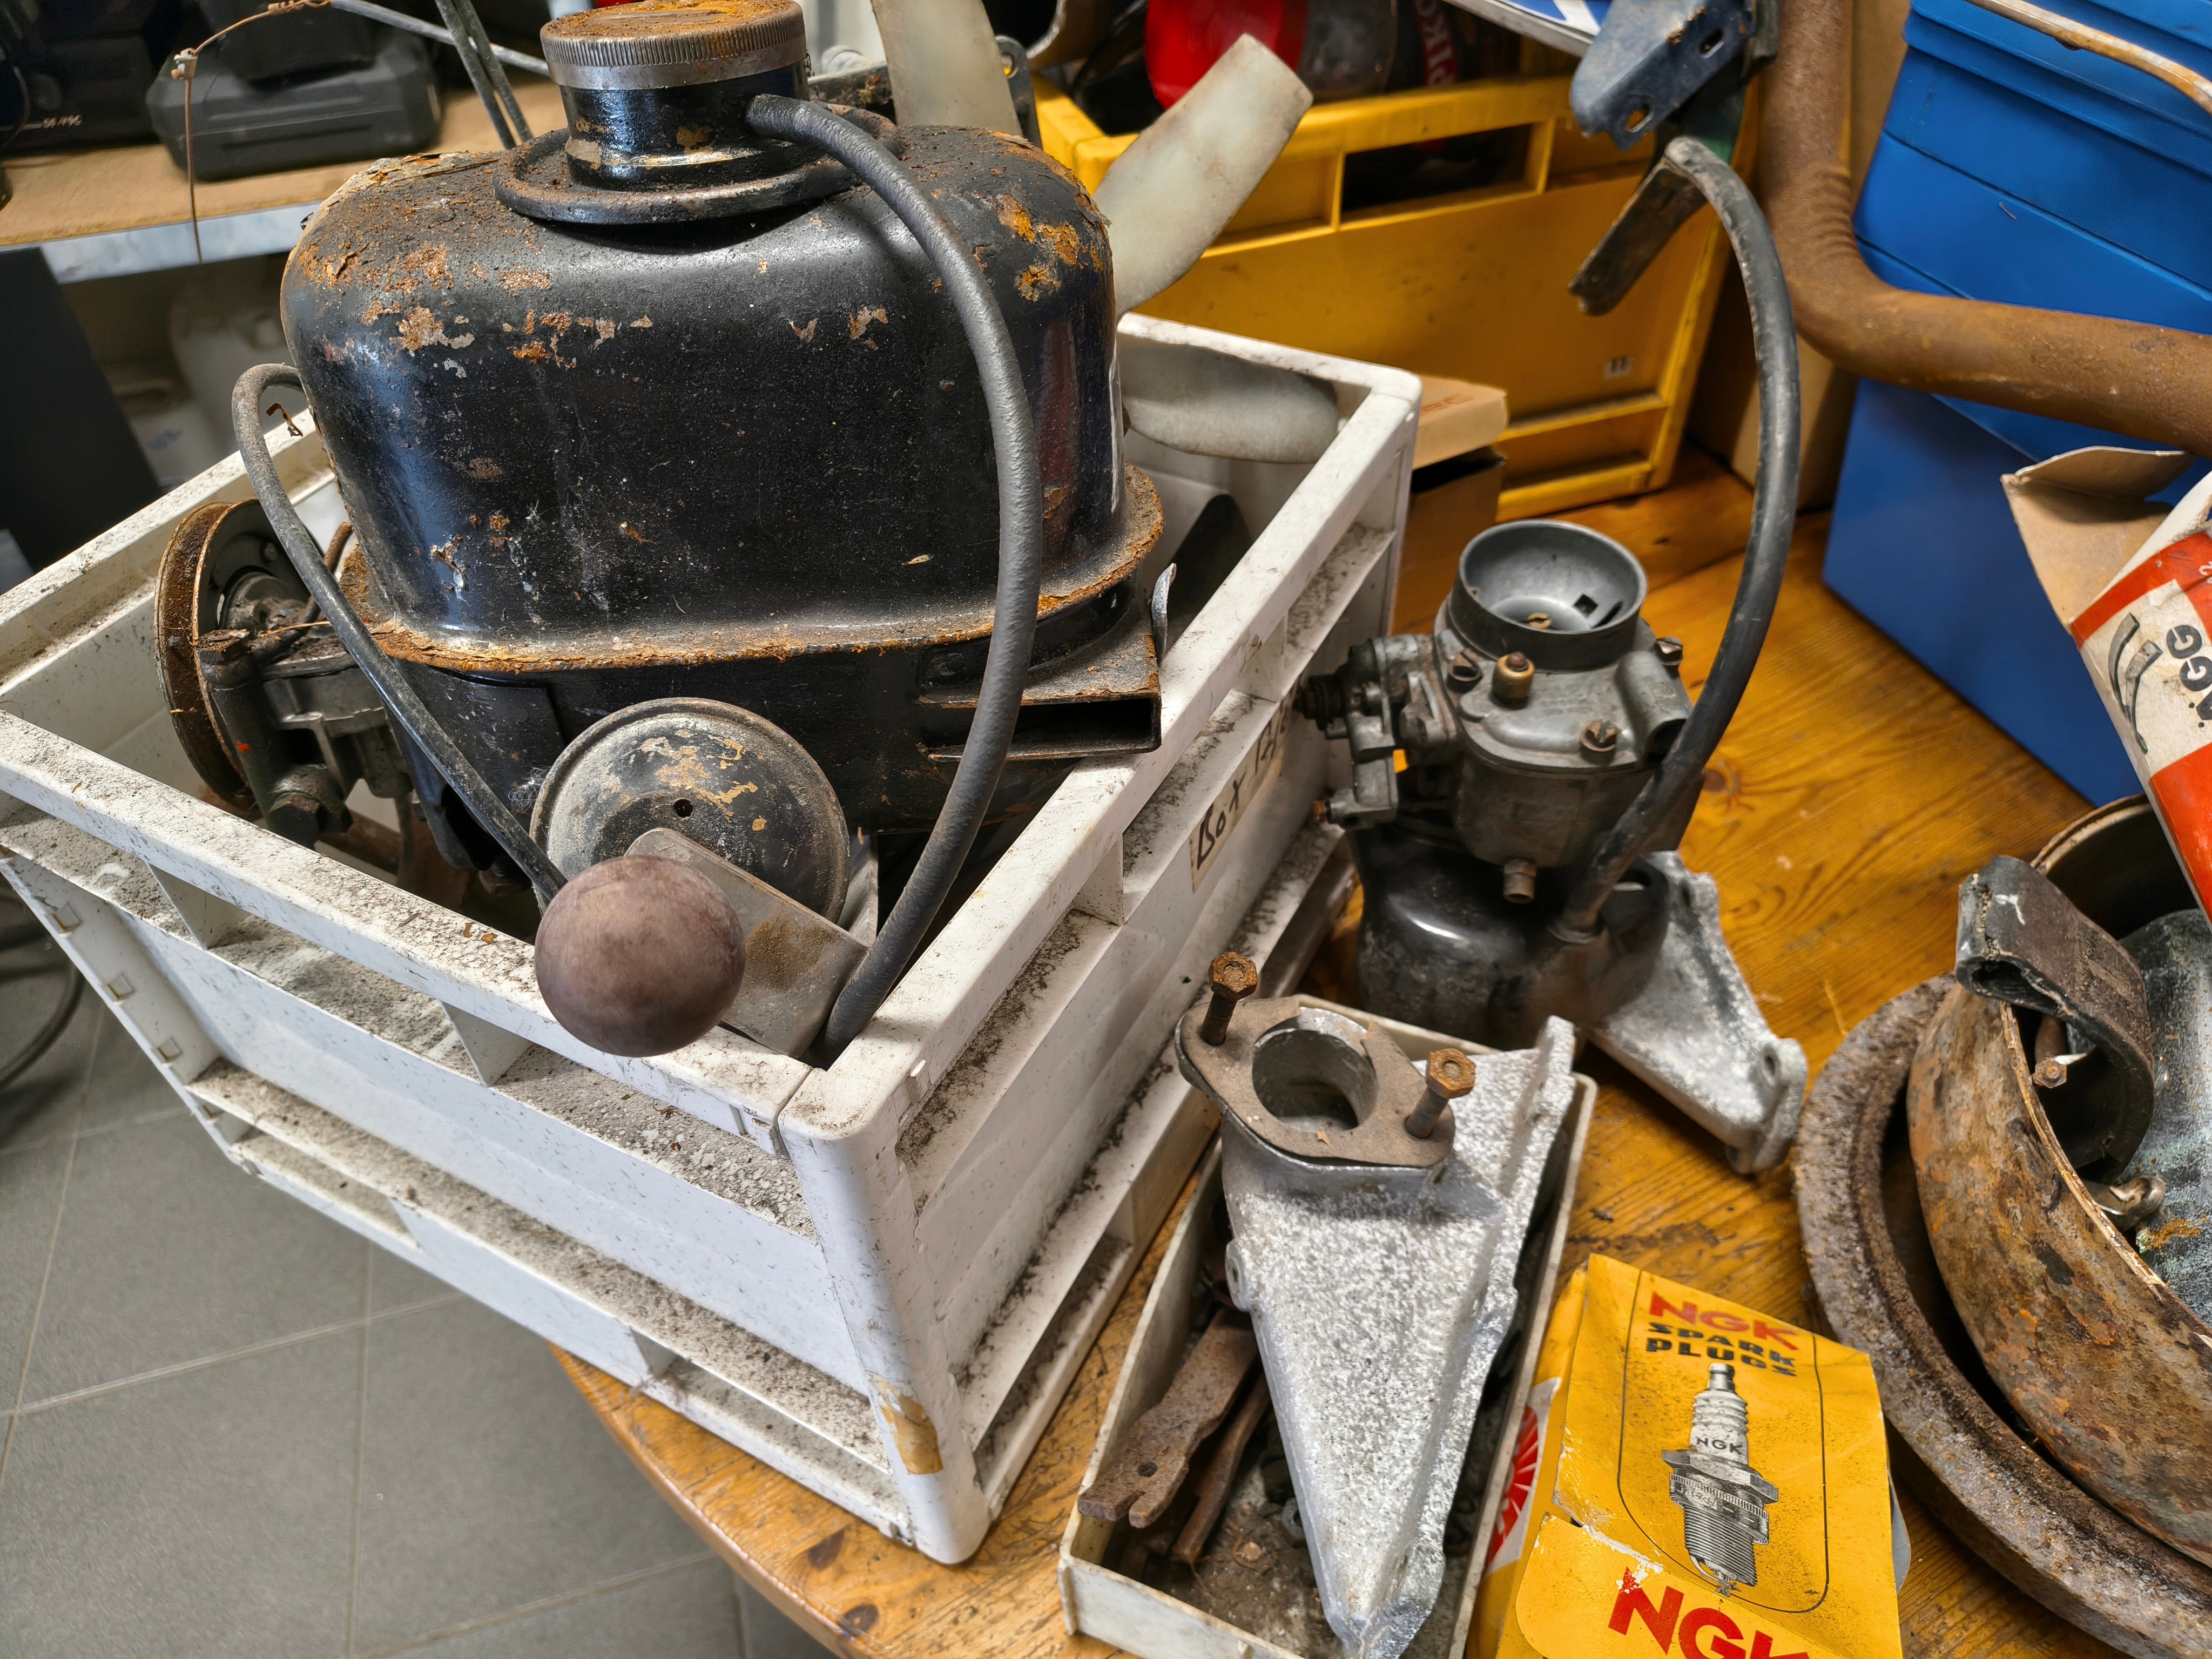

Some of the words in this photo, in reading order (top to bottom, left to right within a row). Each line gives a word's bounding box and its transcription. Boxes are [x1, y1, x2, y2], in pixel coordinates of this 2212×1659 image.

[1649, 1291, 1799, 1351] NGK
[1645, 1337, 1797, 1377] PLUGS
[1648, 1321, 1795, 1368] SPARK
[1696, 1437, 1743, 1455] NGK
